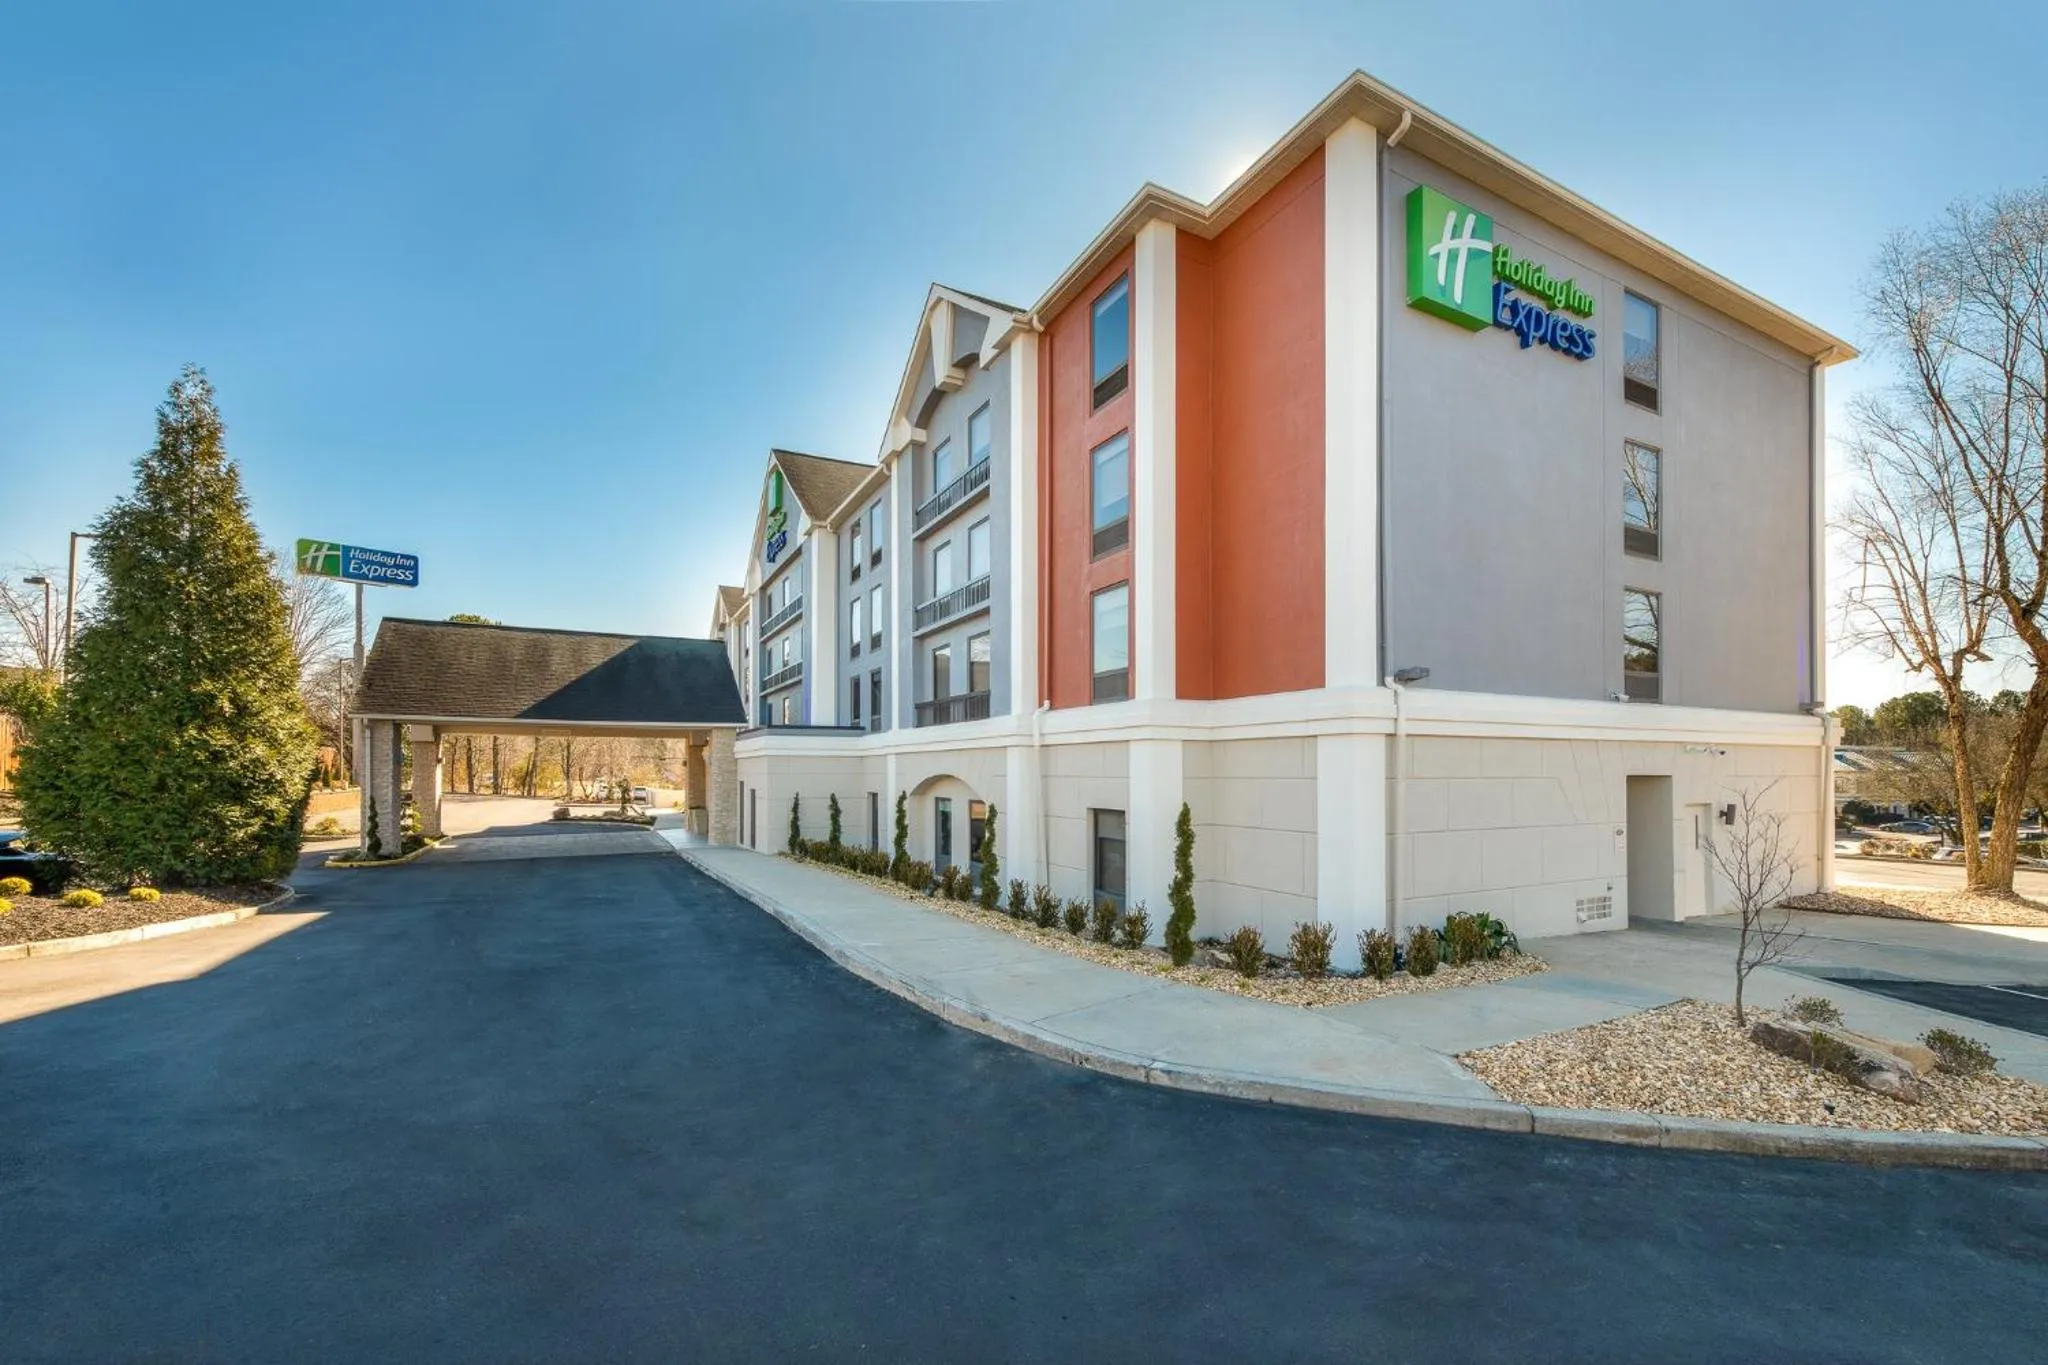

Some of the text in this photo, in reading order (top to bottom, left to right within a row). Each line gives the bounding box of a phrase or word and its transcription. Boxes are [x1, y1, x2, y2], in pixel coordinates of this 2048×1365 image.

[1494, 243, 1595, 318] Holiday Inn
[1494, 282, 1597, 360] Express
[349, 560, 415, 580] Express
[350, 548, 415, 567] Holiday Inn
